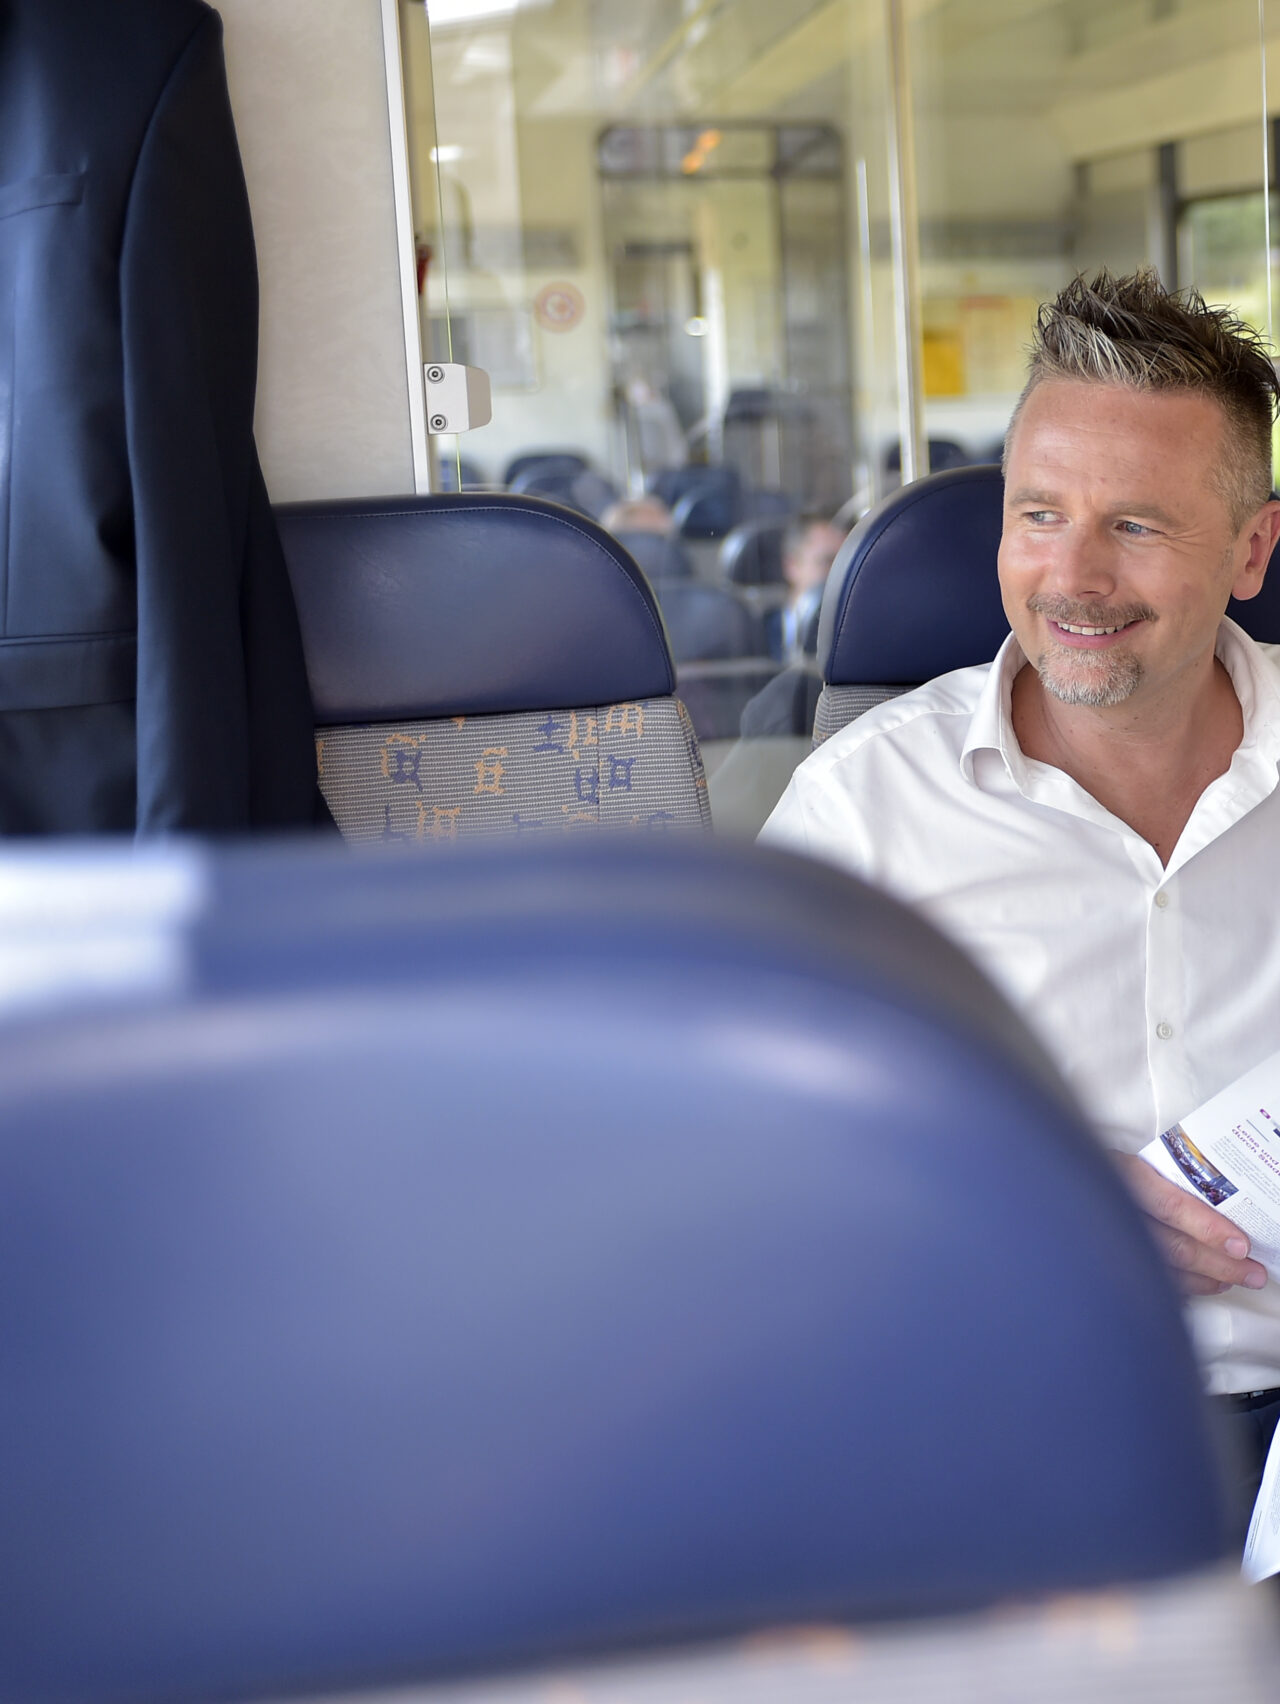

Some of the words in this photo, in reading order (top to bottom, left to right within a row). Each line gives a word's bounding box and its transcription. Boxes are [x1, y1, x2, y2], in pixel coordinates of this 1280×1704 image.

[1231, 1128, 1257, 1153] durch
[1236, 1124, 1260, 1148] Leise
[1261, 1149, 1279, 1166] und
